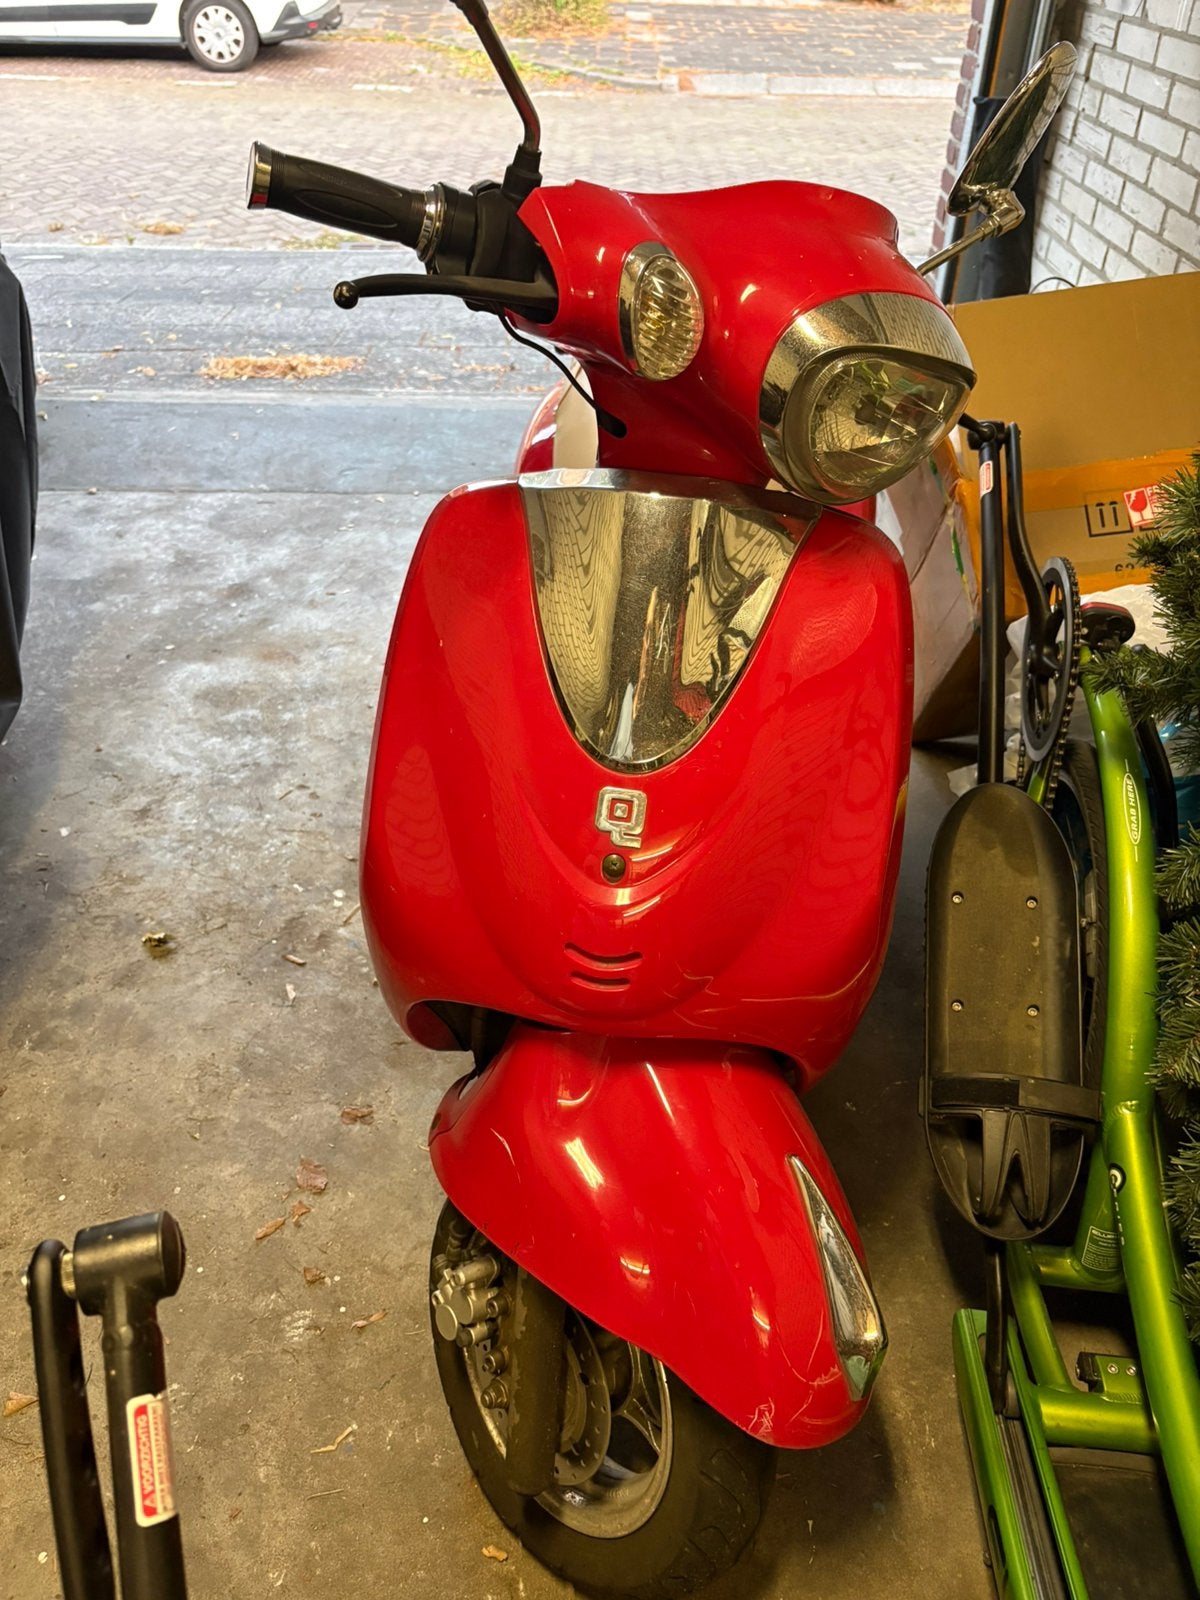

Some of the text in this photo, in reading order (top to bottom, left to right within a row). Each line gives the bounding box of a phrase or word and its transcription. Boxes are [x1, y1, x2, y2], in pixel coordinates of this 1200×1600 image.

[1126, 778, 1138, 840] GRAB HERE
[136, 1413, 154, 1495] VOORZICHTIG
